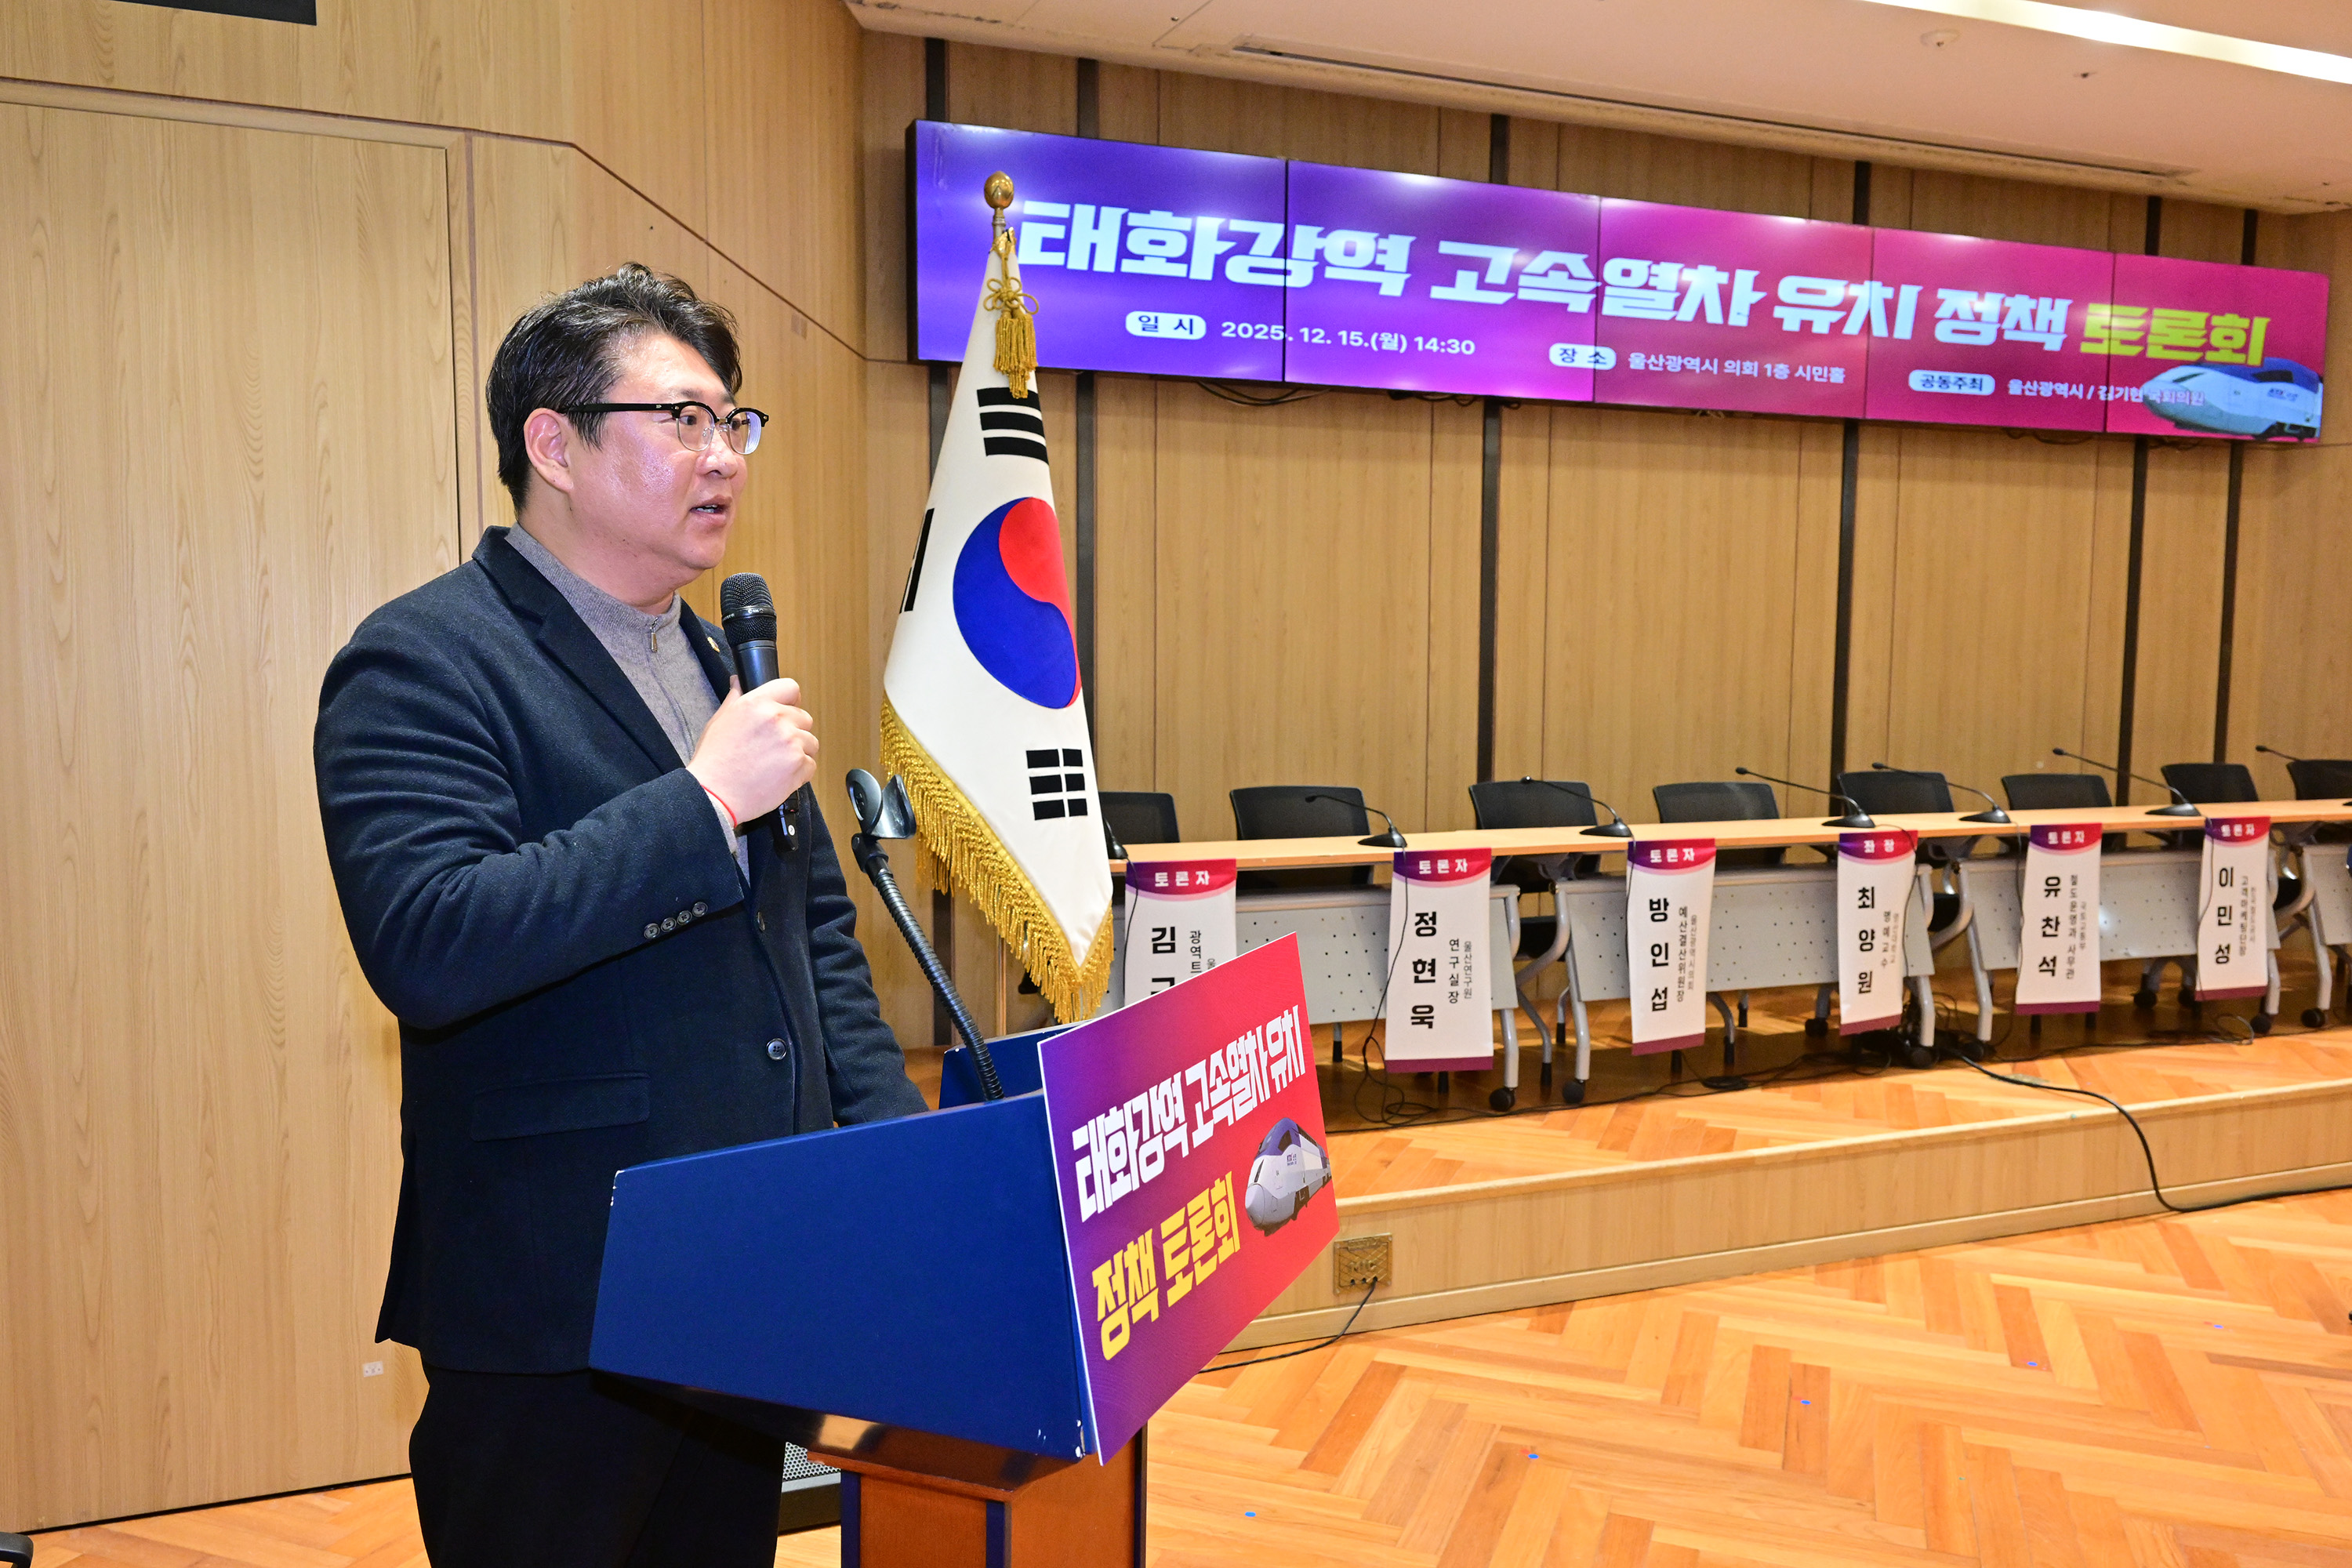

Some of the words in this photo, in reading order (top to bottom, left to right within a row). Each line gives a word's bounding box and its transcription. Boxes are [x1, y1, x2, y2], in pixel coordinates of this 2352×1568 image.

[1017, 200, 1414, 297] 태화강역
[1429, 240, 1766, 326] 고속열차
[1773, 275, 1931, 341] 유치
[1933, 287, 2073, 352] 정책
[2080, 303, 2270, 366] 토론회
[1300, 326, 1331, 346] 12.
[1414, 336, 1475, 356] 14:30
[1628, 351, 1719, 376] 울산광역시
[1723, 357, 1759, 379] 의회
[1765, 362, 1790, 380] 1층
[1795, 364, 1846, 384] 시민홀
[1919, 373, 1984, 392] 공동주최
[2008, 379, 2083, 401] 울산광역시
[2098, 384, 2144, 404] 김기현
[1448, 938, 1459, 1004] 연구실장
[1464, 941, 1472, 999] 울산연구원
[1073, 1072, 1189, 1223] 태화강역
[1185, 1025, 1272, 1149] 고속열차
[1265, 1004, 1305, 1094] 유치
[1092, 1227, 1160, 1361] 정책
[1160, 1171, 1241, 1308] 토론회
